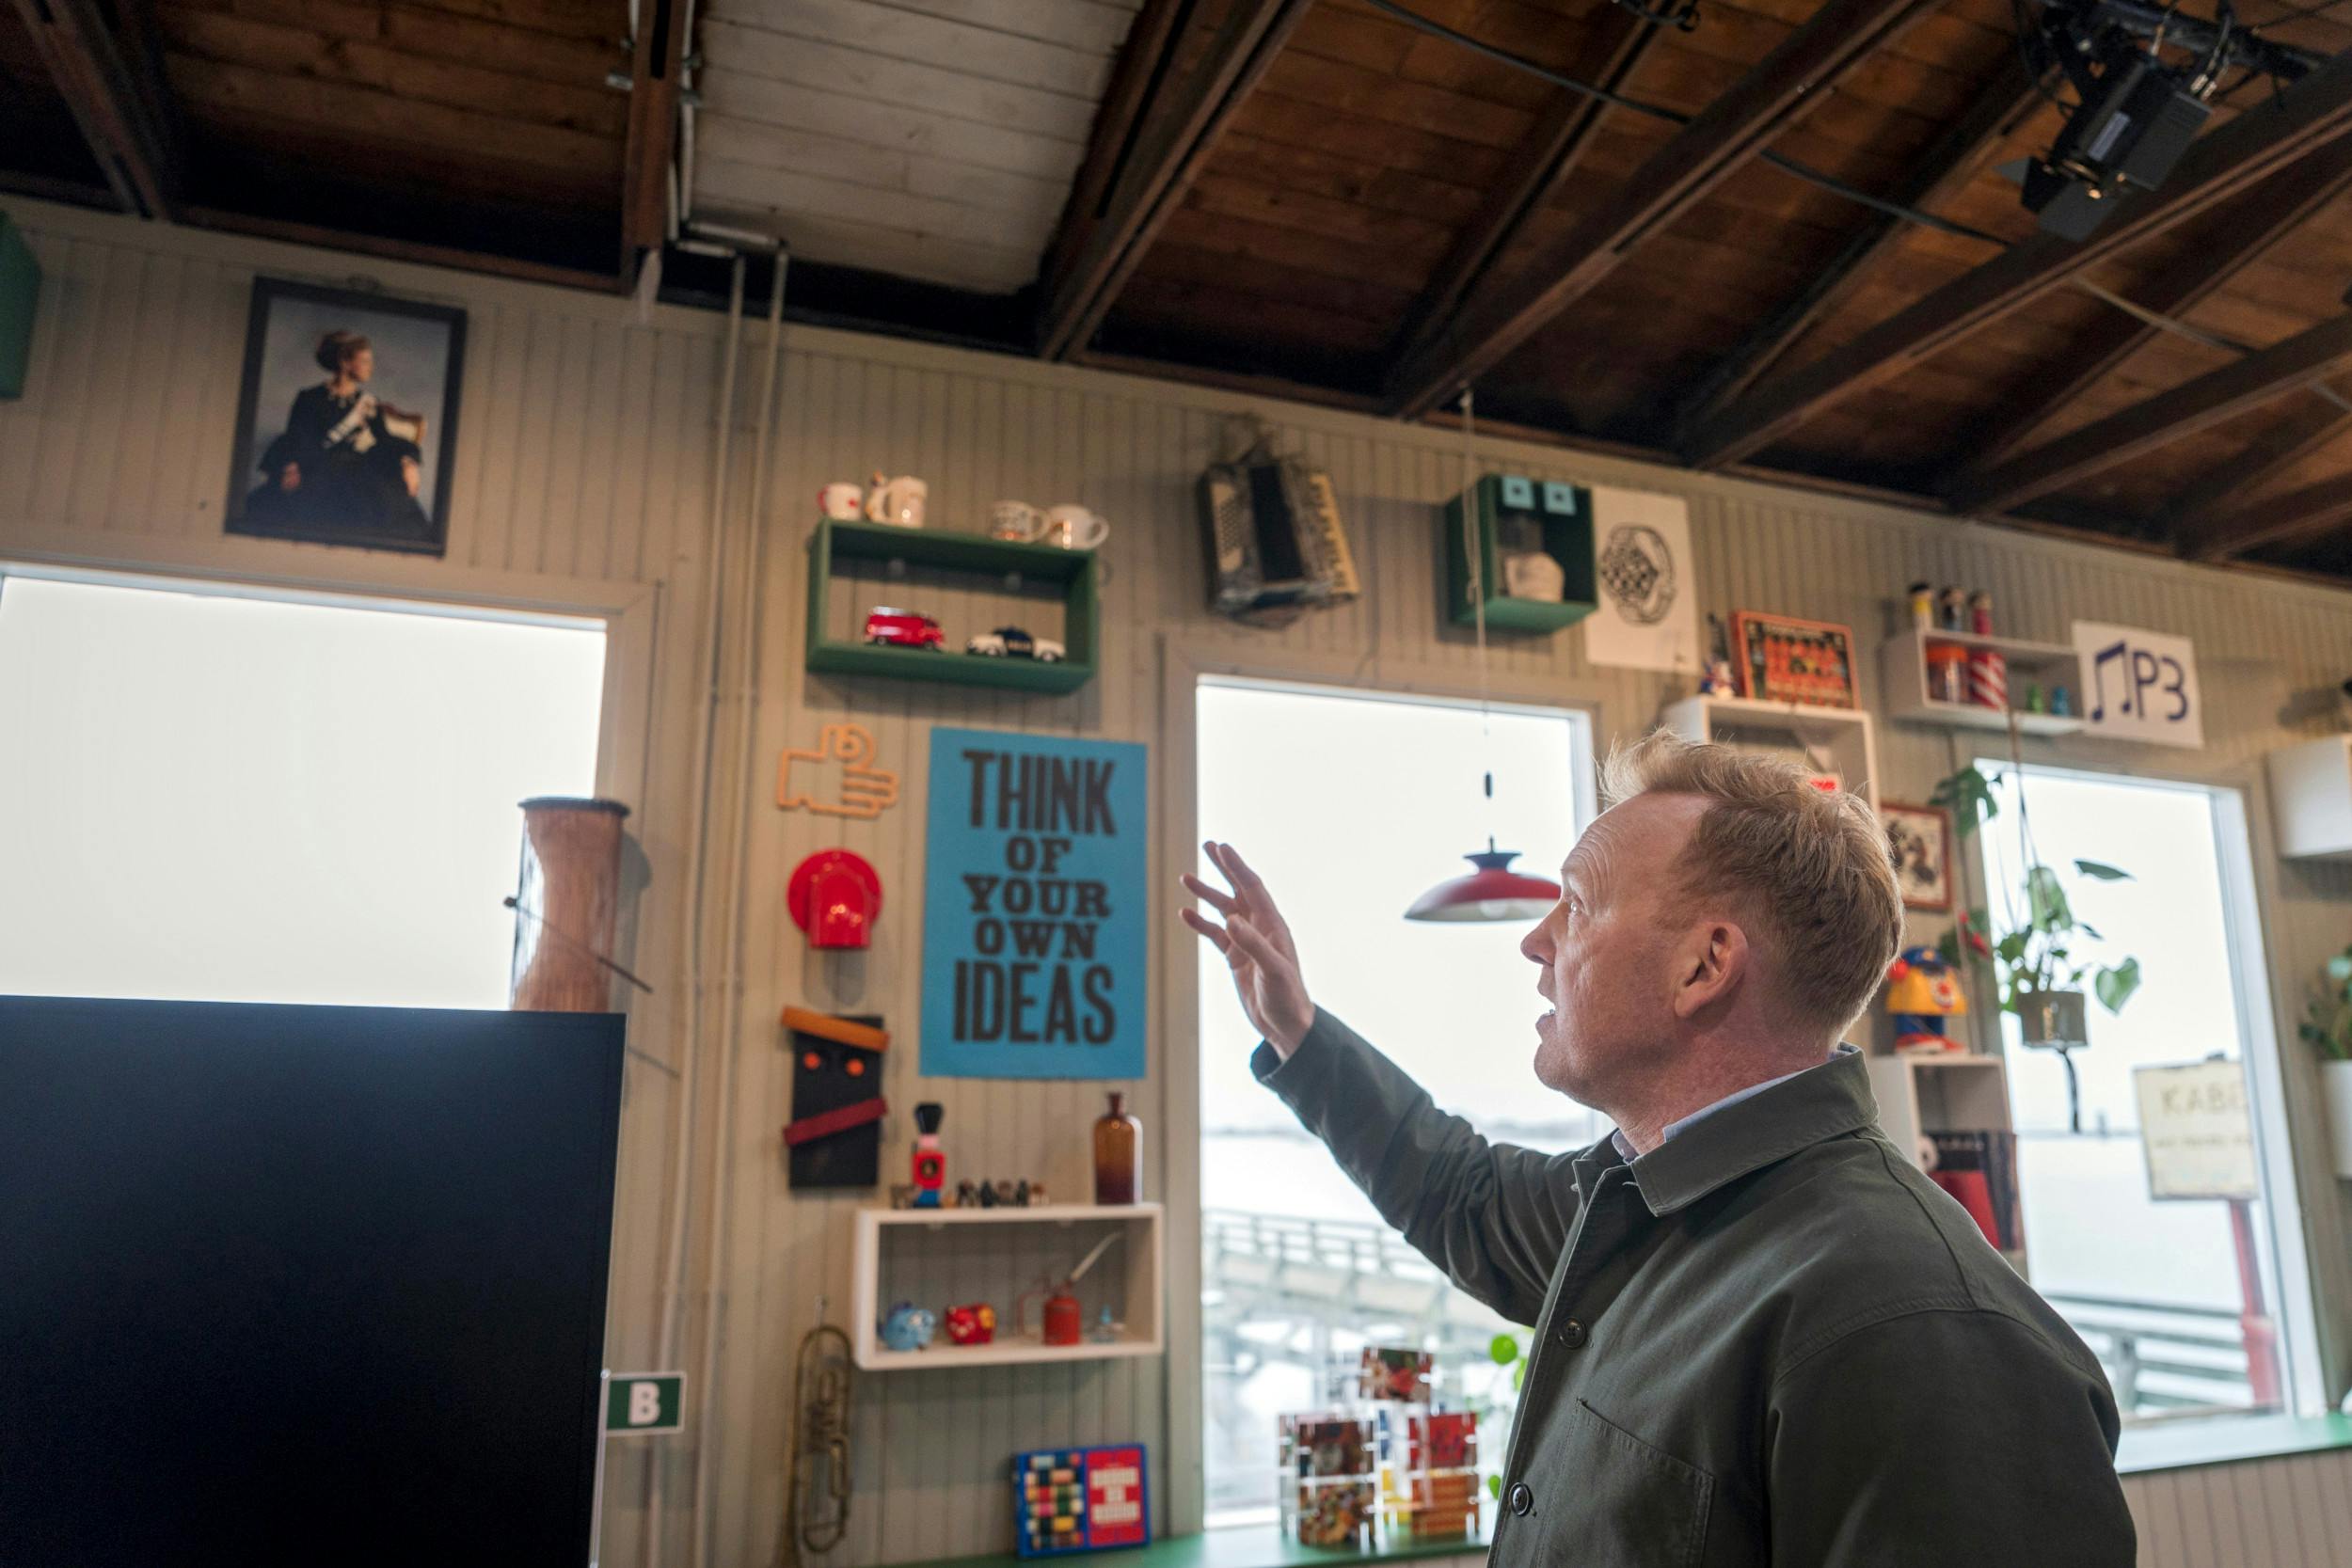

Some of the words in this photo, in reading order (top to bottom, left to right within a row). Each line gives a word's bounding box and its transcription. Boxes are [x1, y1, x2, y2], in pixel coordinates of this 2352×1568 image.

[961, 750, 1117, 835] THINK
[1005, 836, 1073, 875] OF
[961, 875, 1111, 917] YOUR
[974, 917, 1098, 959] OWN
[952, 959, 1117, 1045] IDEAS
[629, 1381, 660, 1426] B
